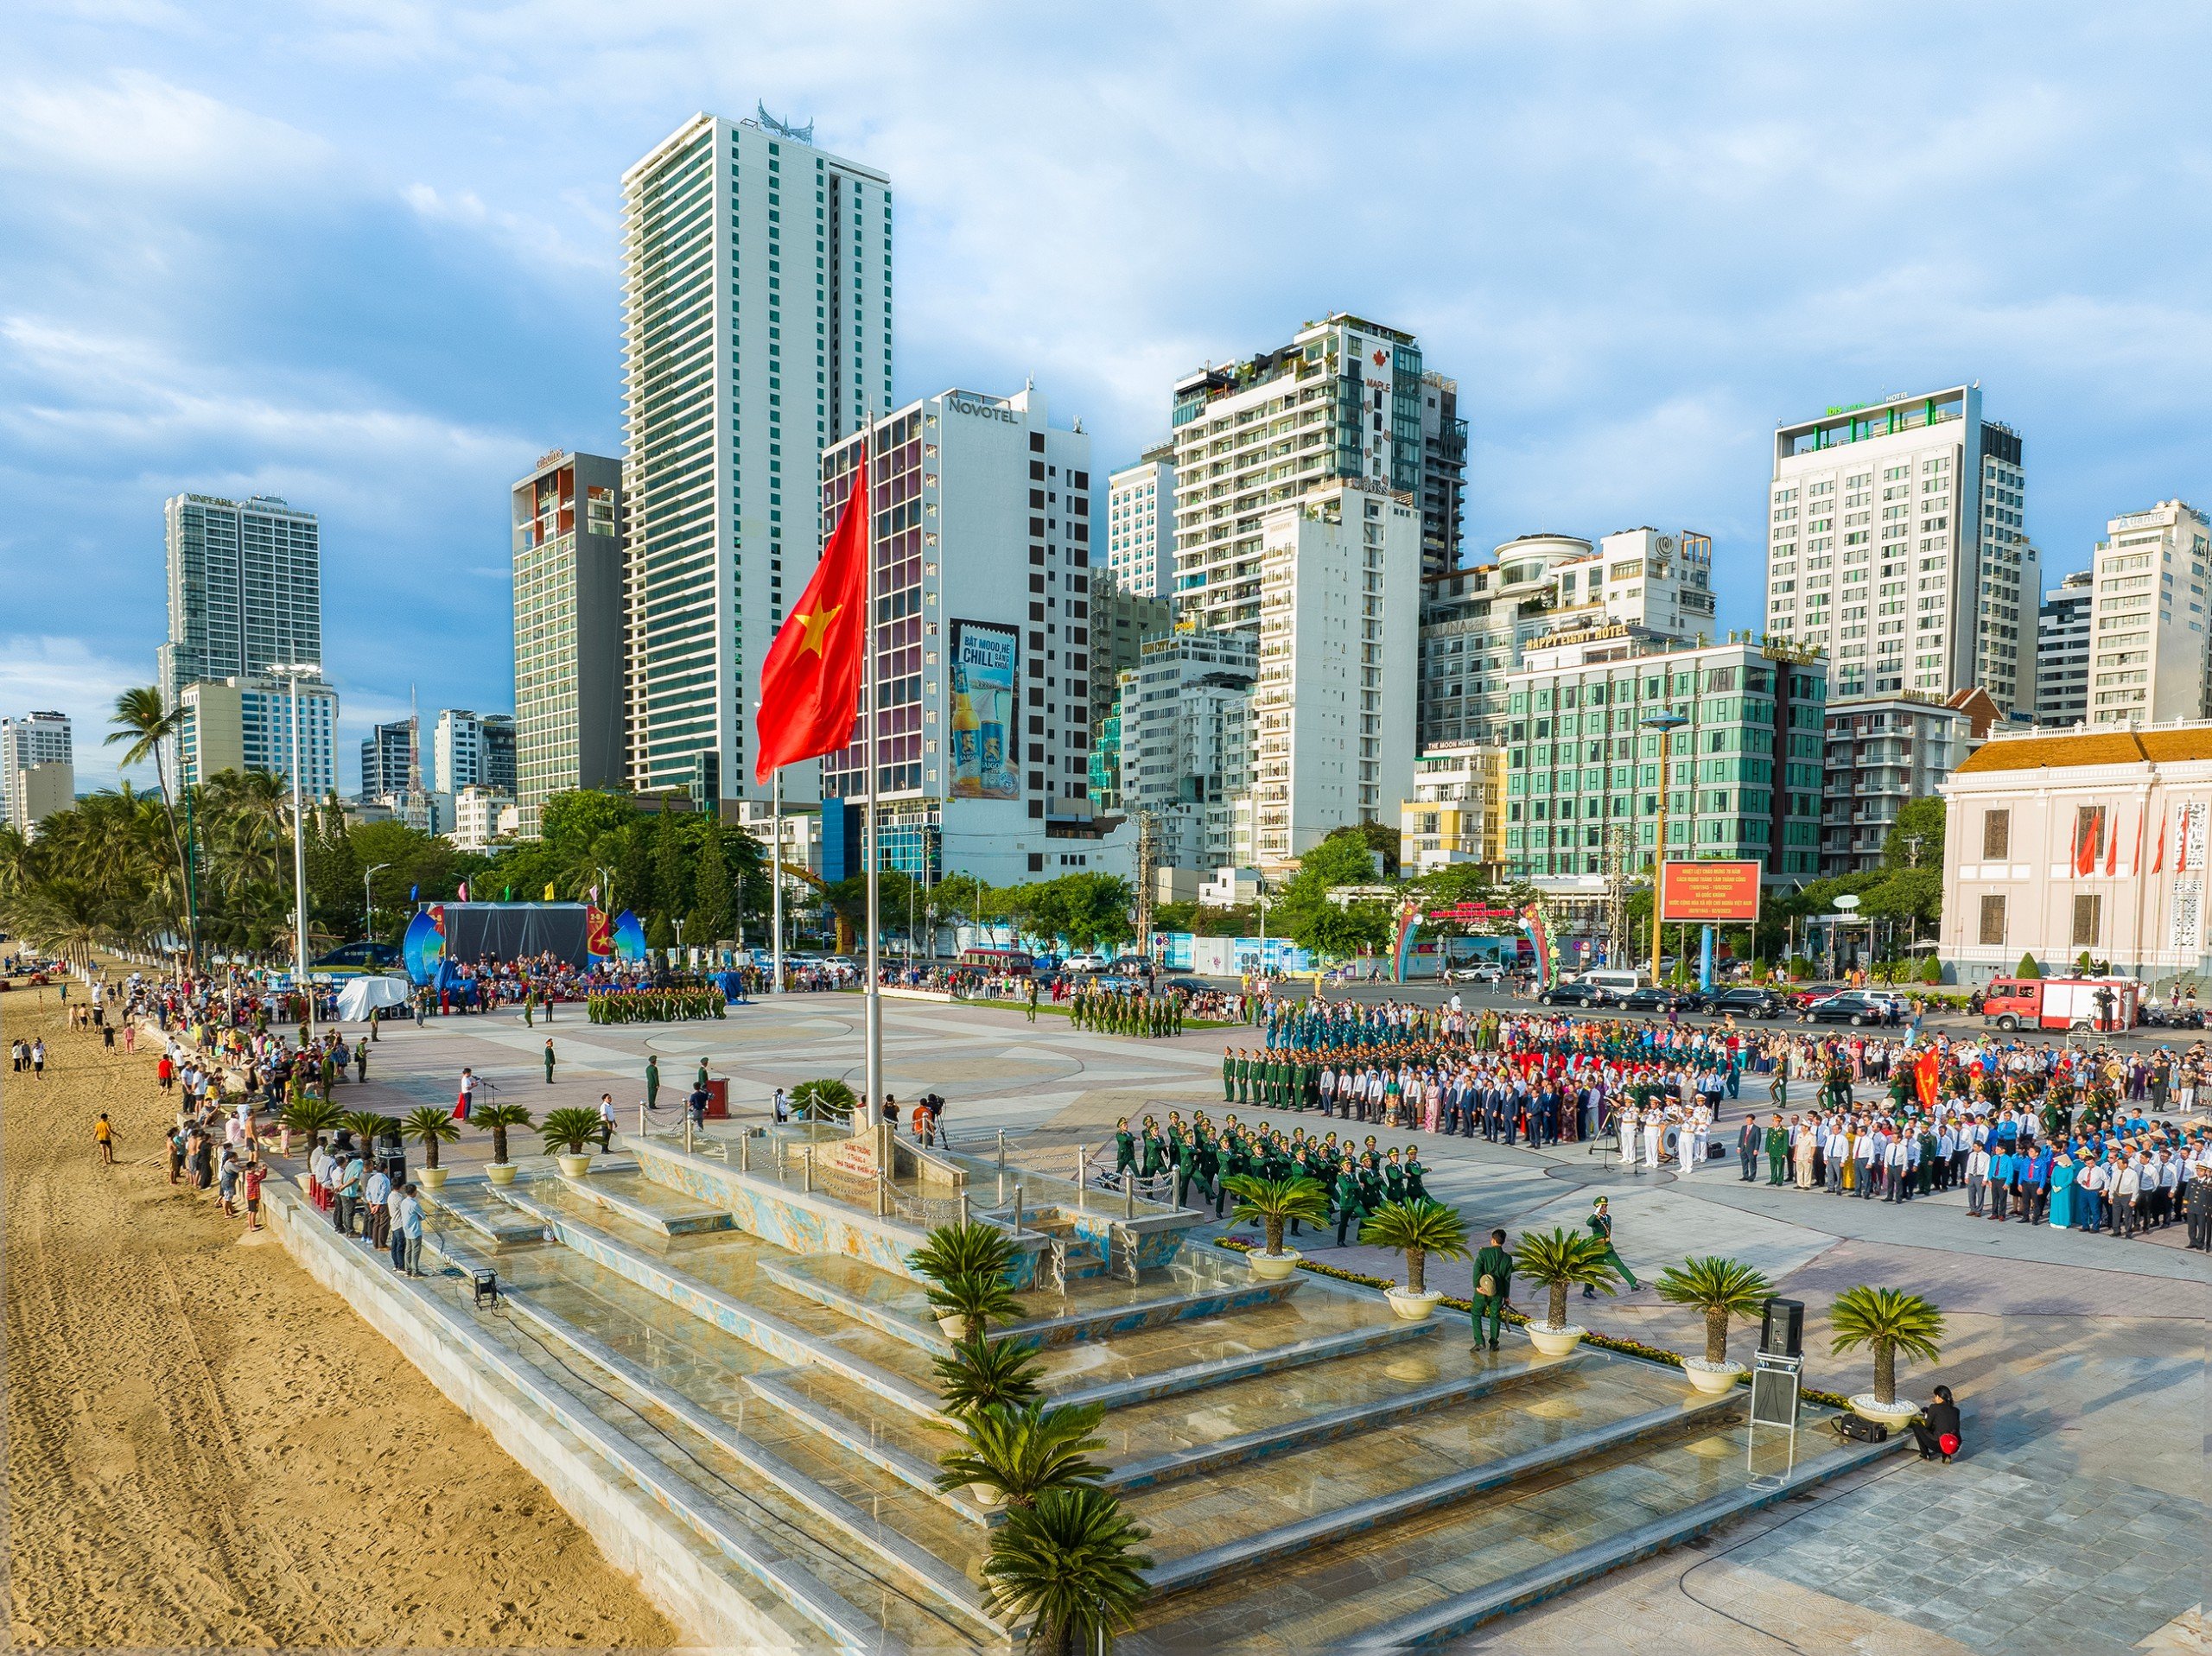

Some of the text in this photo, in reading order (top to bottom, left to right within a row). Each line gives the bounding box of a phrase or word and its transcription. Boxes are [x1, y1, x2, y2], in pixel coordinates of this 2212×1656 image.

[1366, 378, 1390, 393] MAPLE
[1886, 391, 1909, 403] HOTEL
[949, 397, 1018, 424] NOVOTEL
[1827, 406, 1842, 416] ibis
[1363, 481, 1388, 496] BOSS
[187, 492, 236, 508] VINPEARL
[2117, 512, 2165, 530] Atlantic
[1525, 634, 1558, 650] HAPPY
[1595, 624, 1629, 640] HOTEL
[978, 639, 1000, 652] MOOD
[963, 647, 994, 667] CHILL
[1439, 740, 1458, 749] MOON
[1458, 739, 1476, 747] HOTEL
